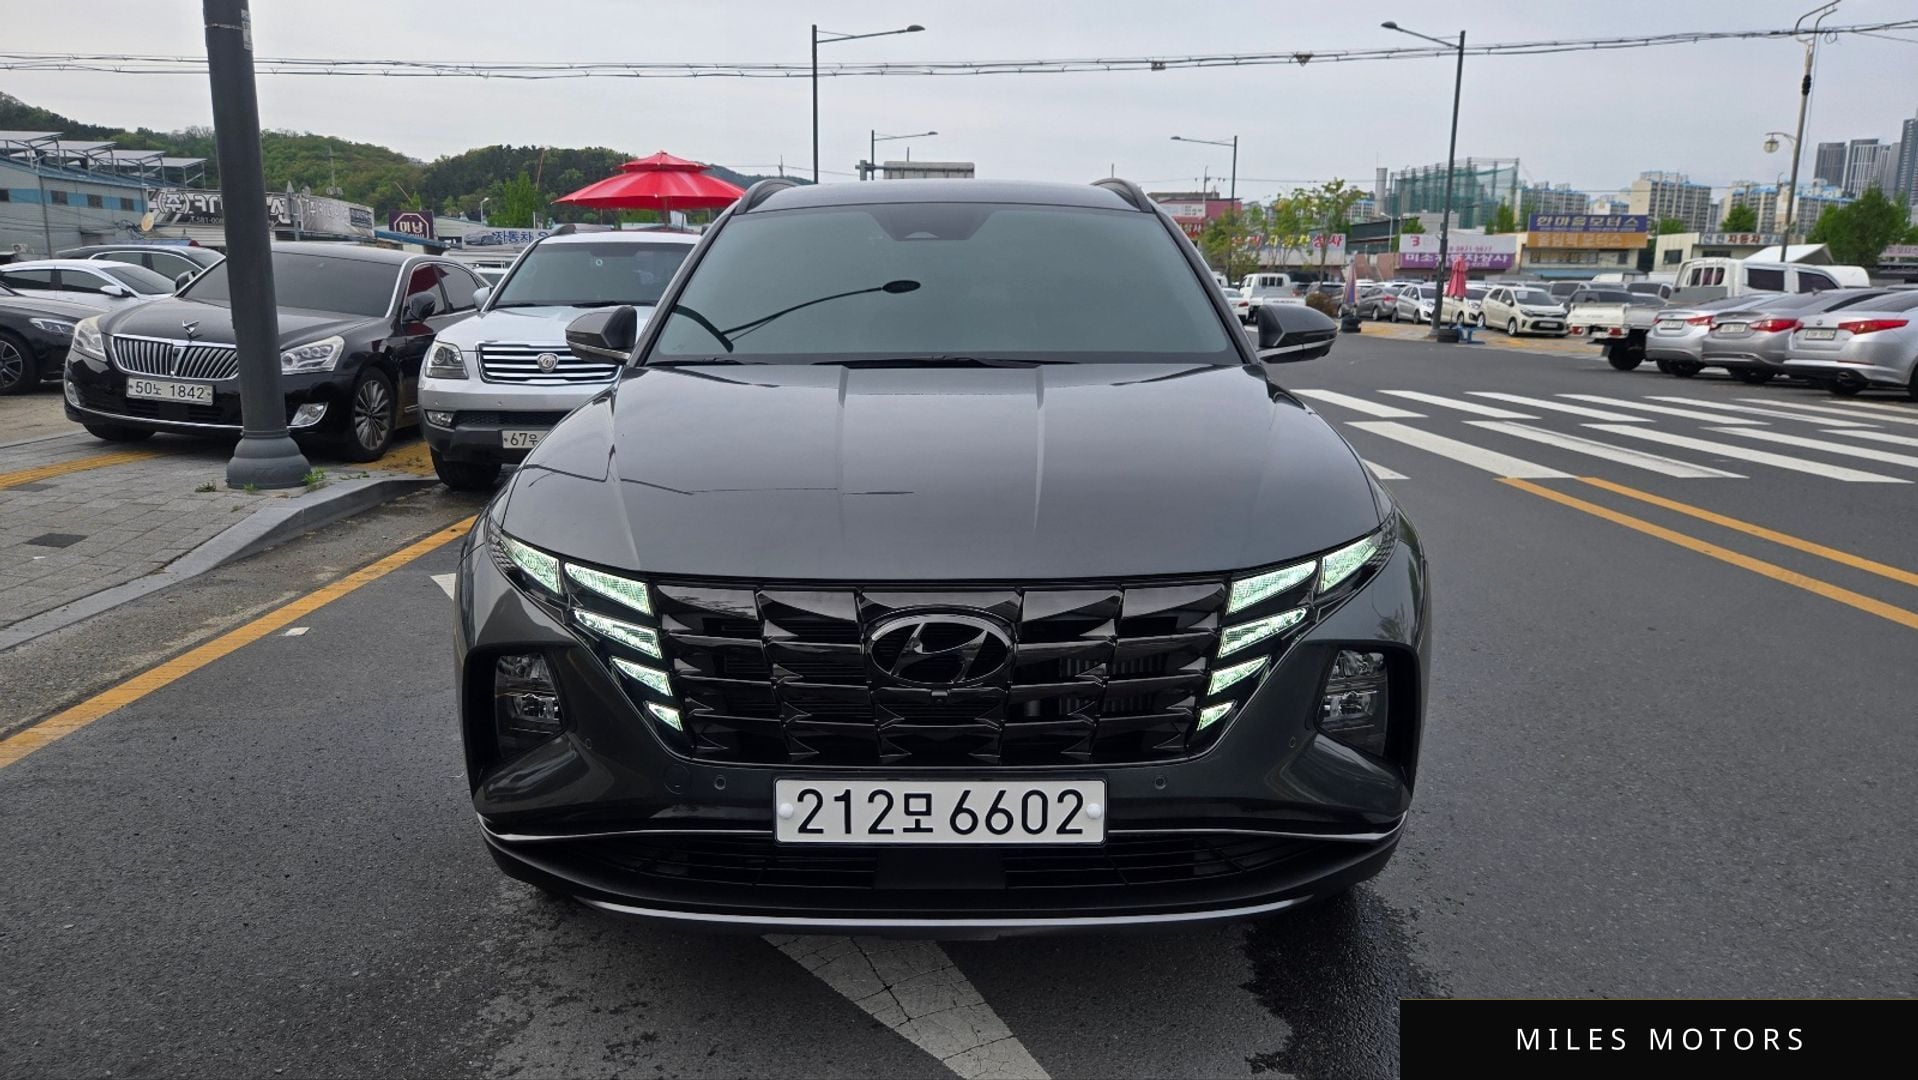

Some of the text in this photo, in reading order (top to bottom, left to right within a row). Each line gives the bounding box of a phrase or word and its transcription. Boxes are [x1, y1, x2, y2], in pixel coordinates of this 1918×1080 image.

[135, 381, 204, 399] 50노 1842
[797, 788, 1084, 835] 212모 6602
